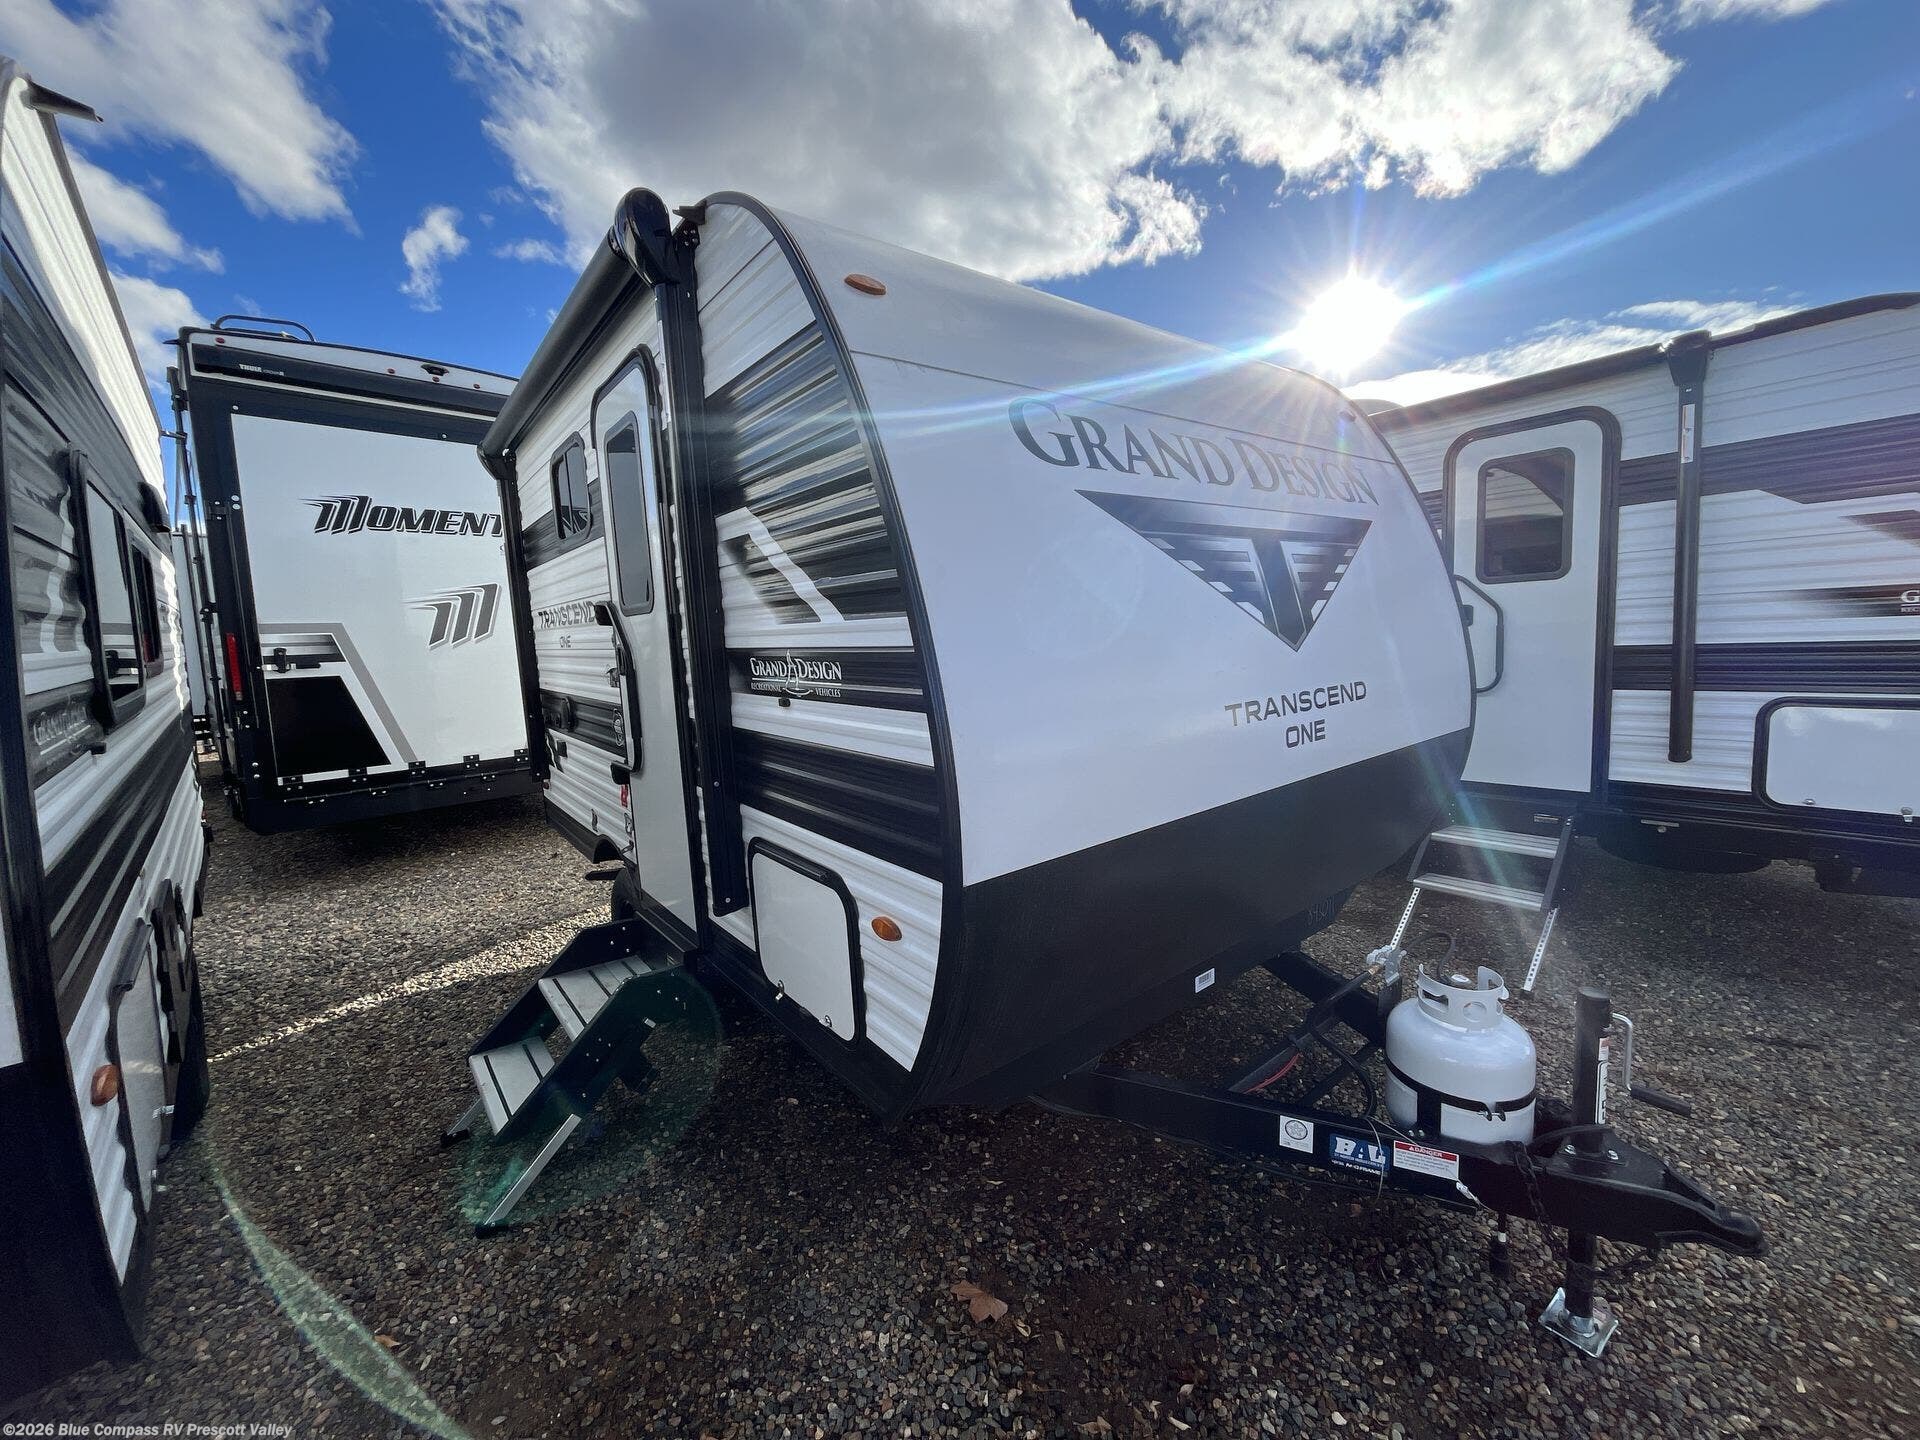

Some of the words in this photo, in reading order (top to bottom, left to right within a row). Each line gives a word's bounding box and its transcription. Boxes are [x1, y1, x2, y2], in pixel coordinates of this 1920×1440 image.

[1008, 397, 1234, 487] GRAND
[1226, 437, 1379, 506] DESIGN
[750, 657, 788, 677] GRAND
[794, 658, 842, 680] DESIGN
[815, 687, 841, 698] VEHICLES
[1224, 681, 1367, 727] TRANSCEND
[1286, 719, 1326, 748] ONE
[1414, 1147, 1443, 1158] DANGER
